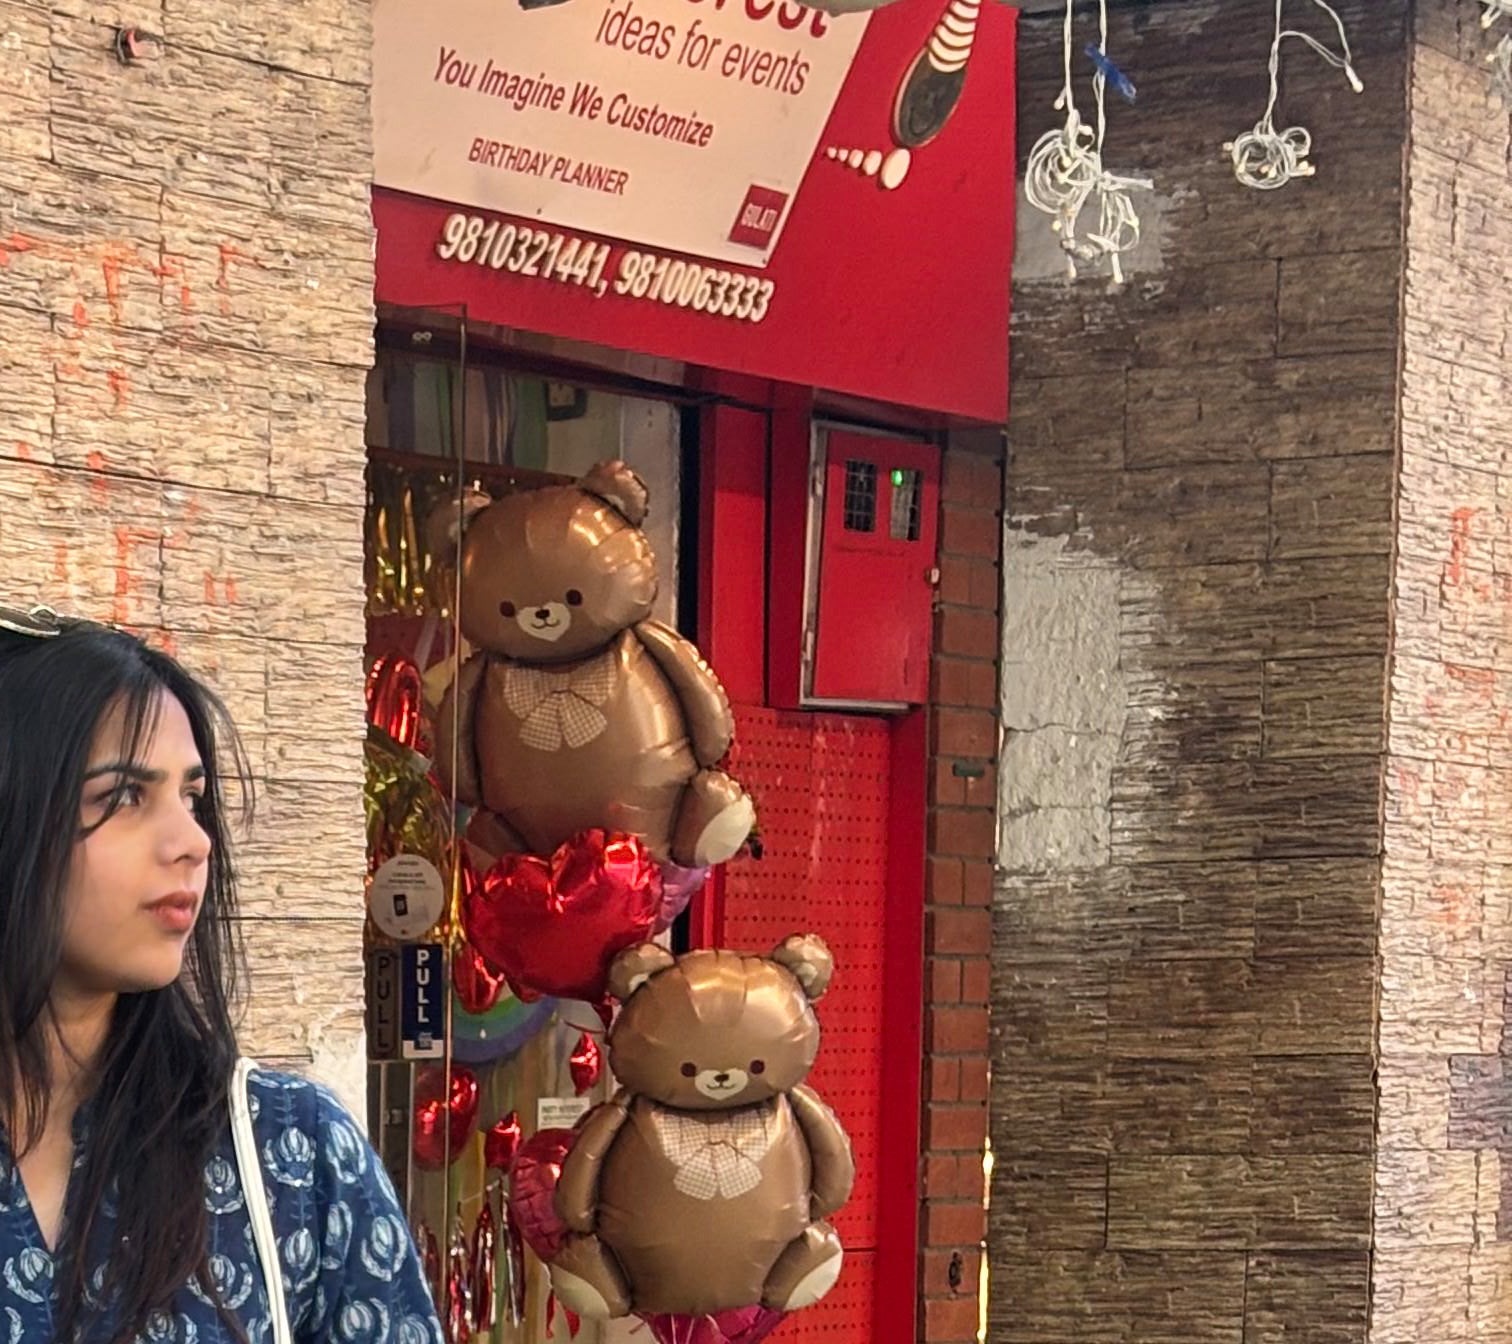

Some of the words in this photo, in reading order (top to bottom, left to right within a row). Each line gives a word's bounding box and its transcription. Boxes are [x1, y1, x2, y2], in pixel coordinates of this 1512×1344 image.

[595, 0, 676, 60] ideas
[678, 19, 722, 72] for
[722, 42, 810, 96] events
[434, 46, 478, 89] You
[478, 59, 566, 112] Imagine
[568, 81, 604, 121] We
[606, 93, 715, 148] Customize
[468, 137, 554, 178] BIRTHDAY
[549, 156, 630, 195] PLANNER
[439, 213, 609, 299] 9810321441,
[615, 251, 775, 323] 9810063333
[416, 949, 430, 1024] PULL
